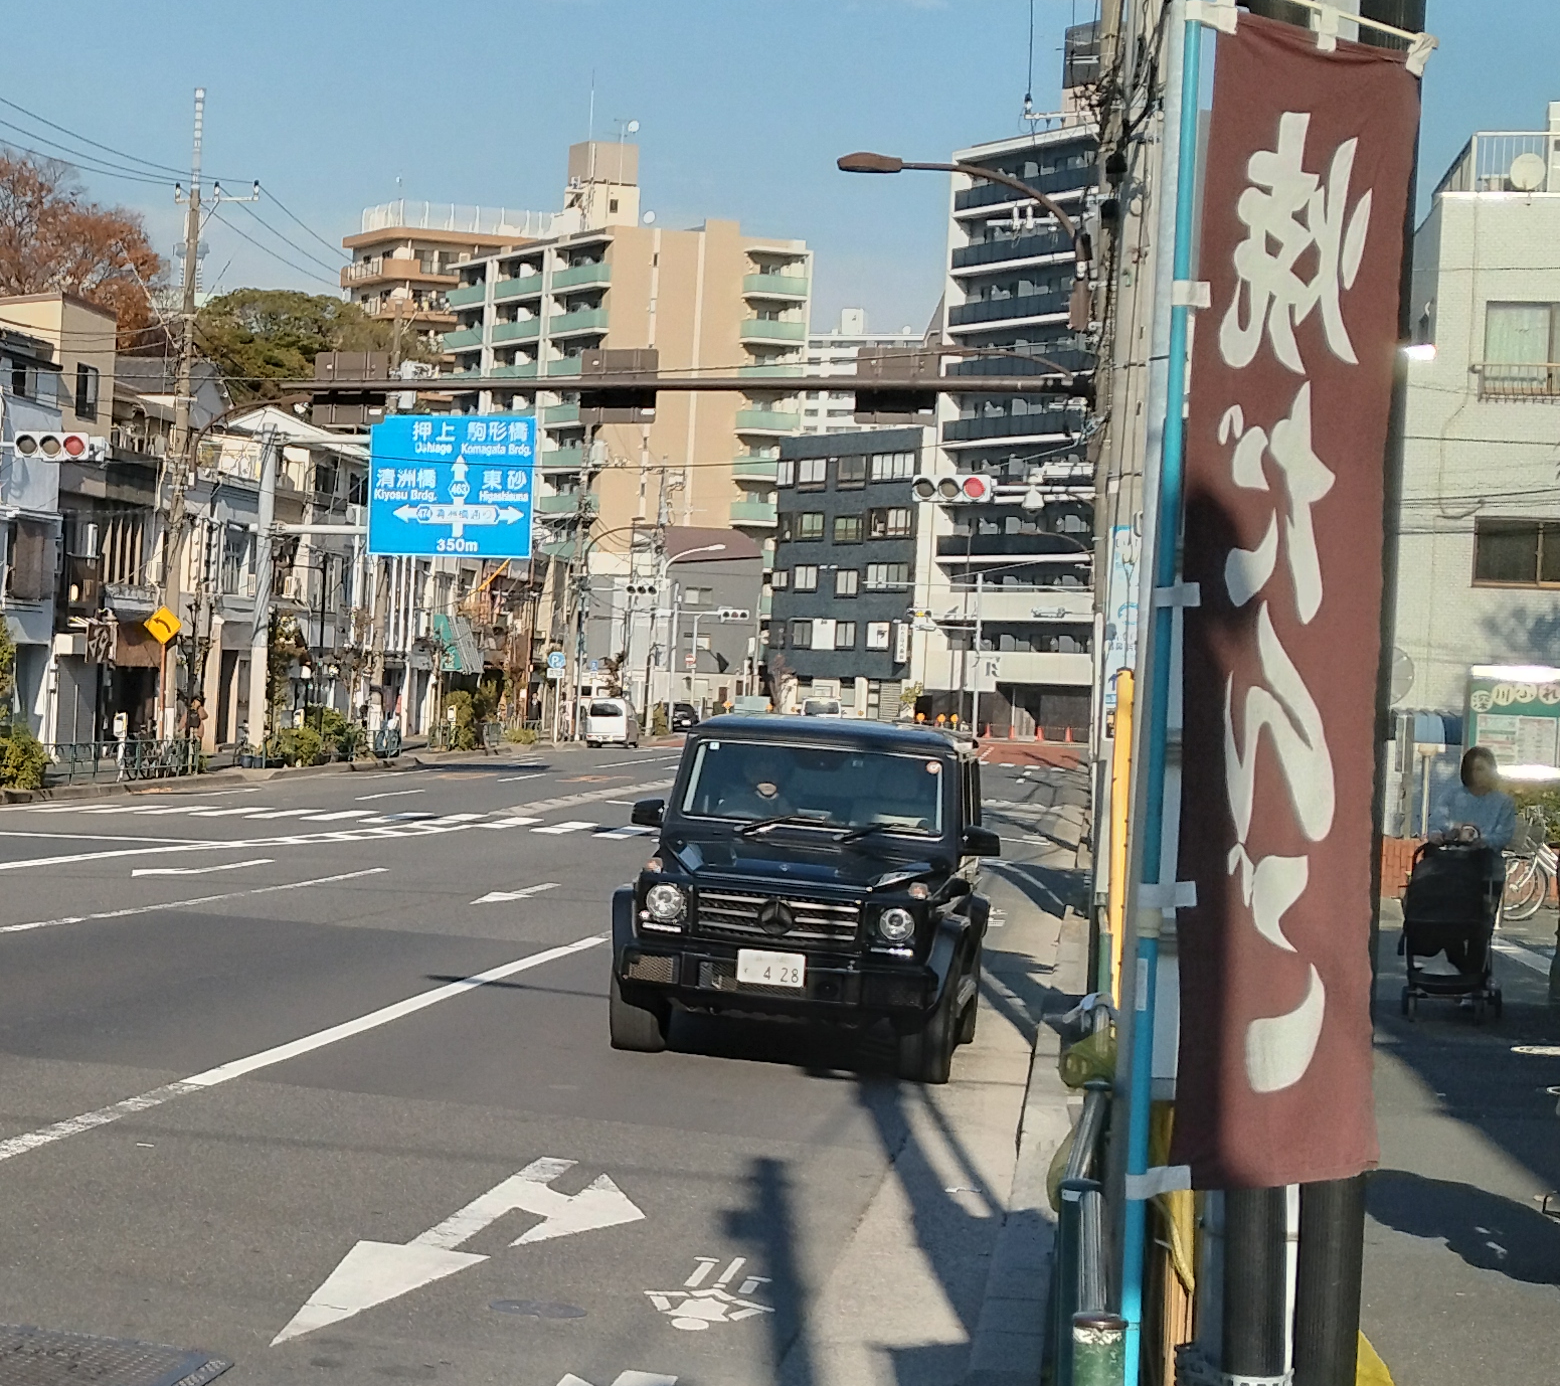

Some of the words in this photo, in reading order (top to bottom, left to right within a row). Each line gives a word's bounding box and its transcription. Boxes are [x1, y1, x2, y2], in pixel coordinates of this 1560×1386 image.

[413, 421, 456, 442] 押上
[468, 421, 529, 442] 駒形橋
[461, 444, 506, 457] Komagata
[508, 444, 532, 458] Brdg.
[376, 468, 437, 489] 清洲橋
[483, 470, 527, 491] 東砂
[374, 489, 409, 502] Kiyosu
[410, 489, 438, 502] Brdg.
[450, 483, 467, 495] 463
[436, 538, 479, 553] 350m
